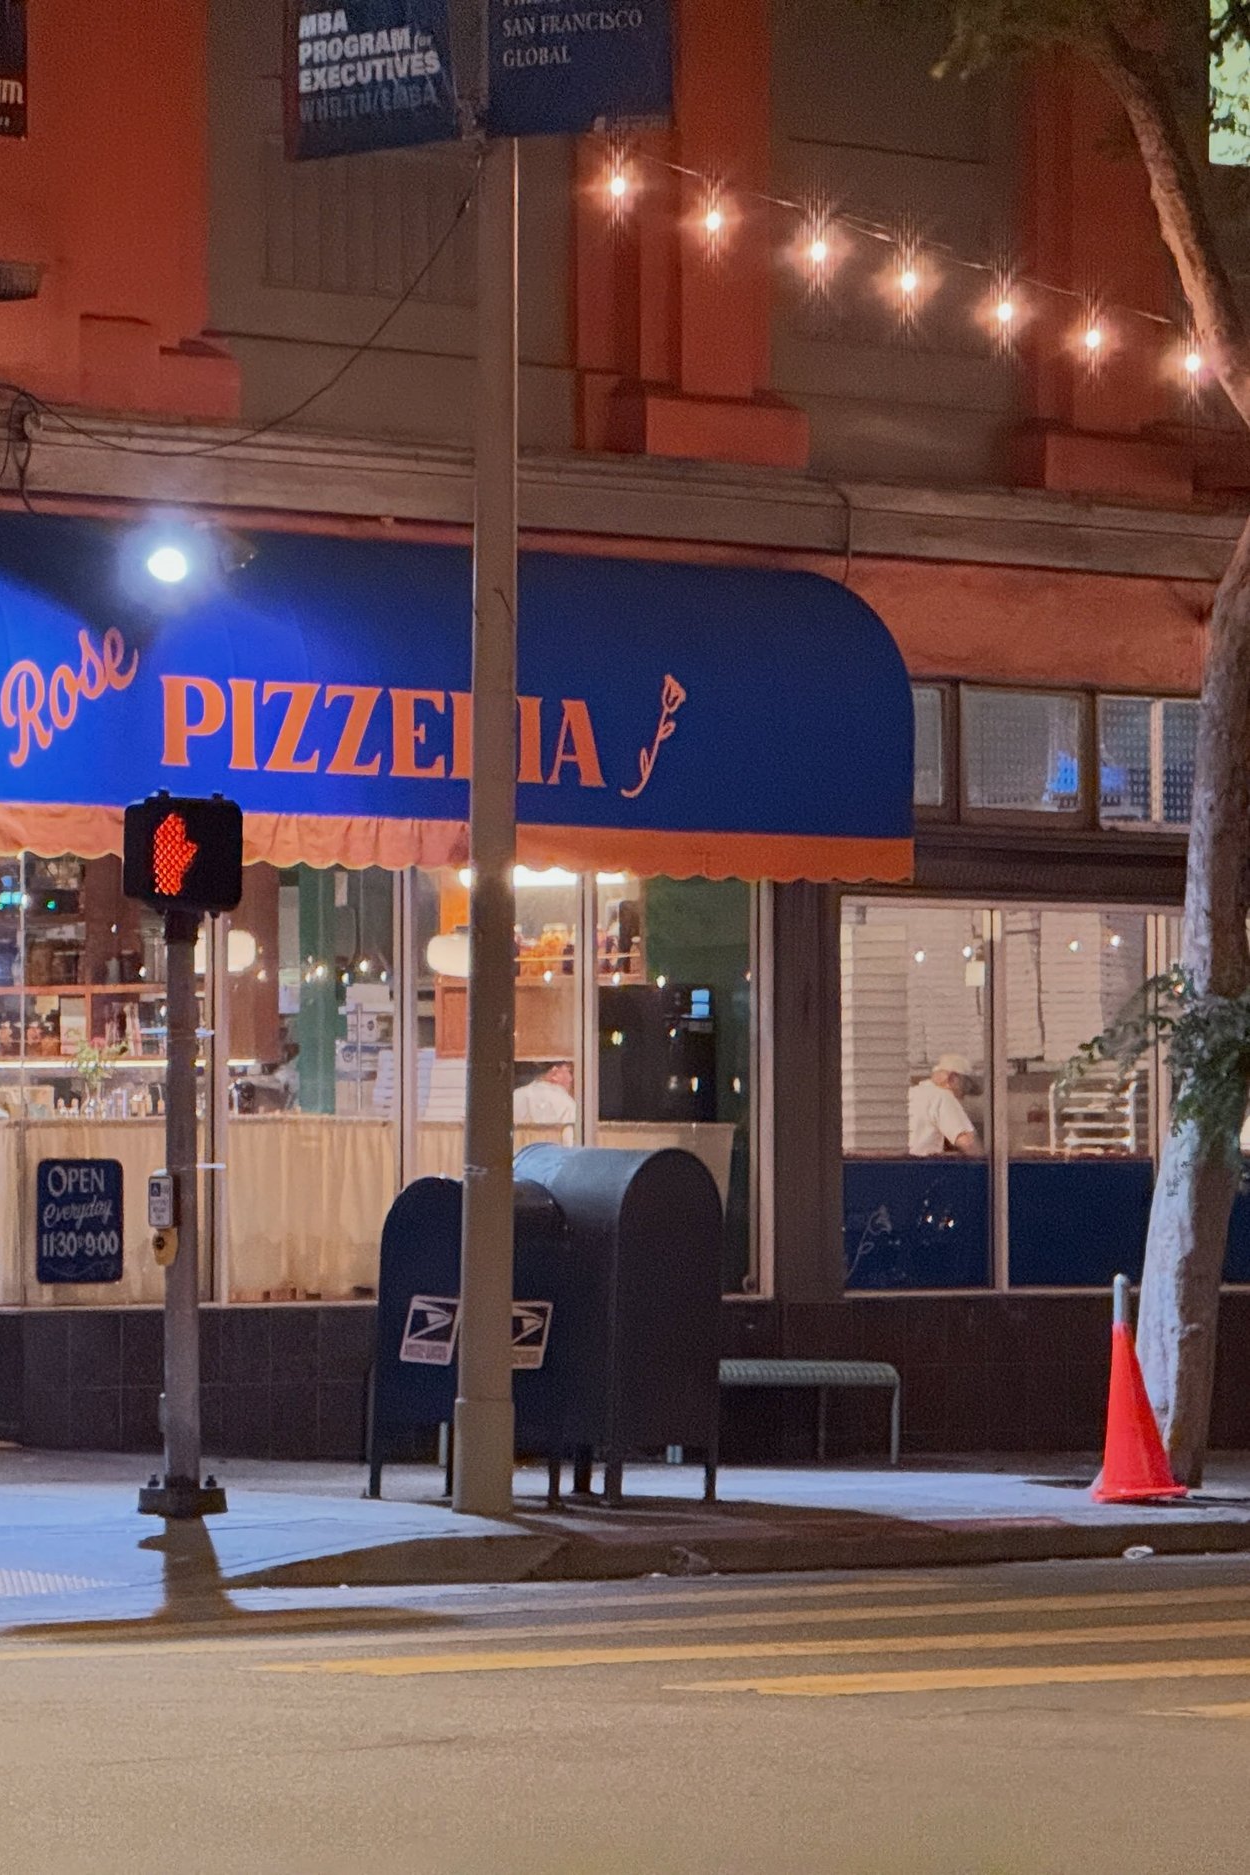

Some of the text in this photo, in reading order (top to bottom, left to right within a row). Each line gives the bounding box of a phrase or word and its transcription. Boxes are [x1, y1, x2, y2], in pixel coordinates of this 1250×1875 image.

[298, 8, 349, 39] MBA
[502, 8, 643, 38] SAN FRANCISCO
[298, 26, 412, 67] PROGRAM
[502, 45, 572, 68] GLOBAL
[298, 50, 442, 94] EXECUTIVES
[0, 627, 138, 768] Rose
[47, 1164, 106, 1197] OPEN
